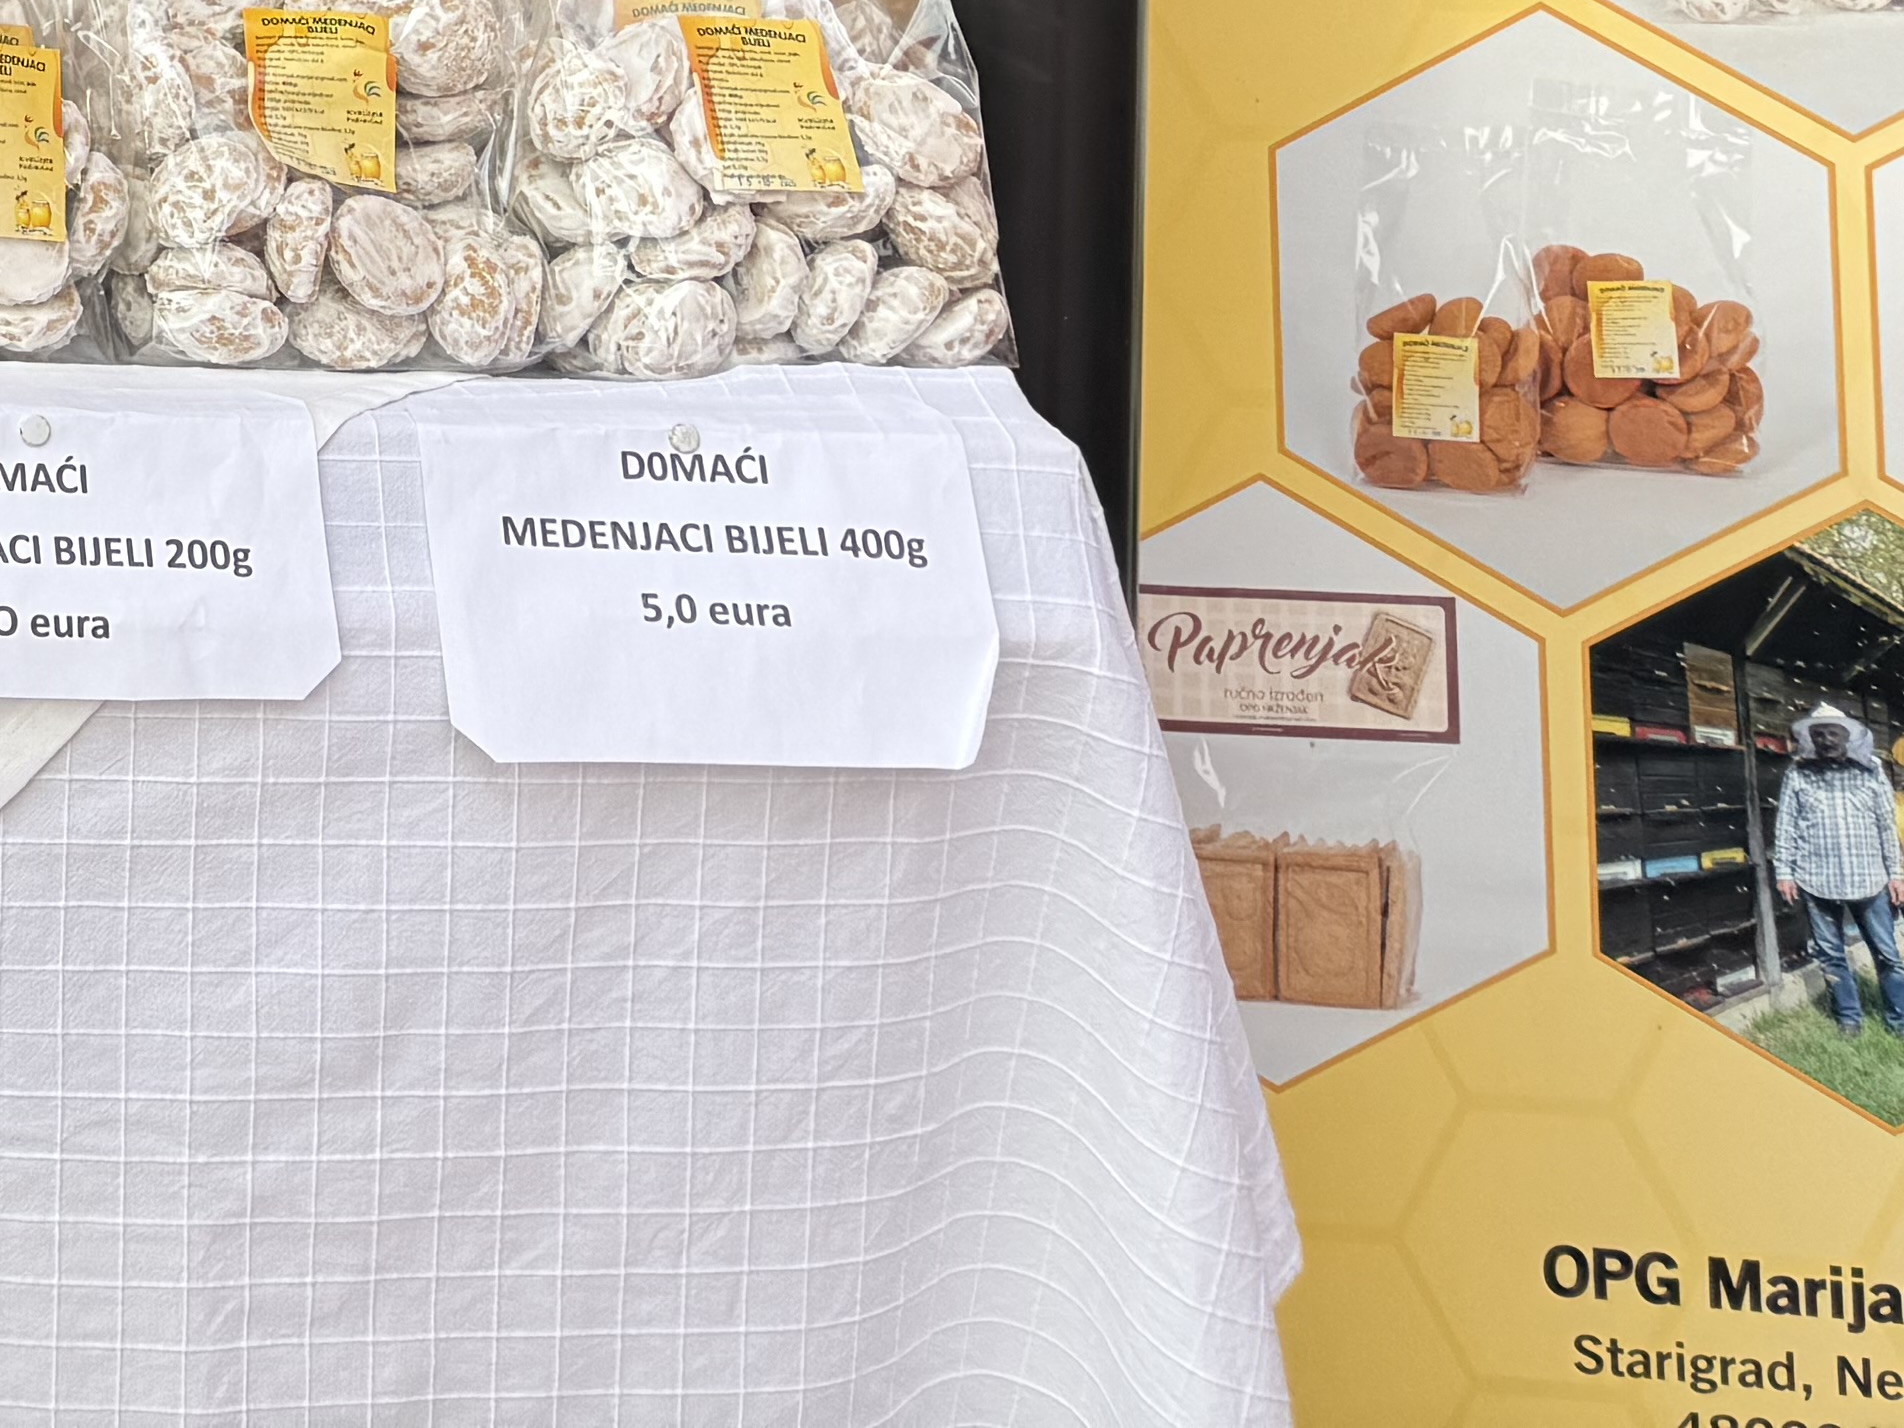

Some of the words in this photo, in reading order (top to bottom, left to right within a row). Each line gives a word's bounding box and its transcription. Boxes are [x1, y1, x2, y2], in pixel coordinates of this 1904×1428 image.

[53, 535, 154, 568] BIJELI
[165, 538, 254, 578] 200g
[500, 516, 715, 553] MEDENJACI
[724, 524, 829, 557] BIJELI
[839, 528, 929, 569] 400g
[30, 613, 112, 640] eura
[640, 592, 698, 629] 5,0
[708, 599, 792, 628] eura
[1147, 611, 1400, 694] Paprenjak
[1543, 1244, 1681, 1306] OPG
[1573, 1333, 1813, 1401] Starigrad,
